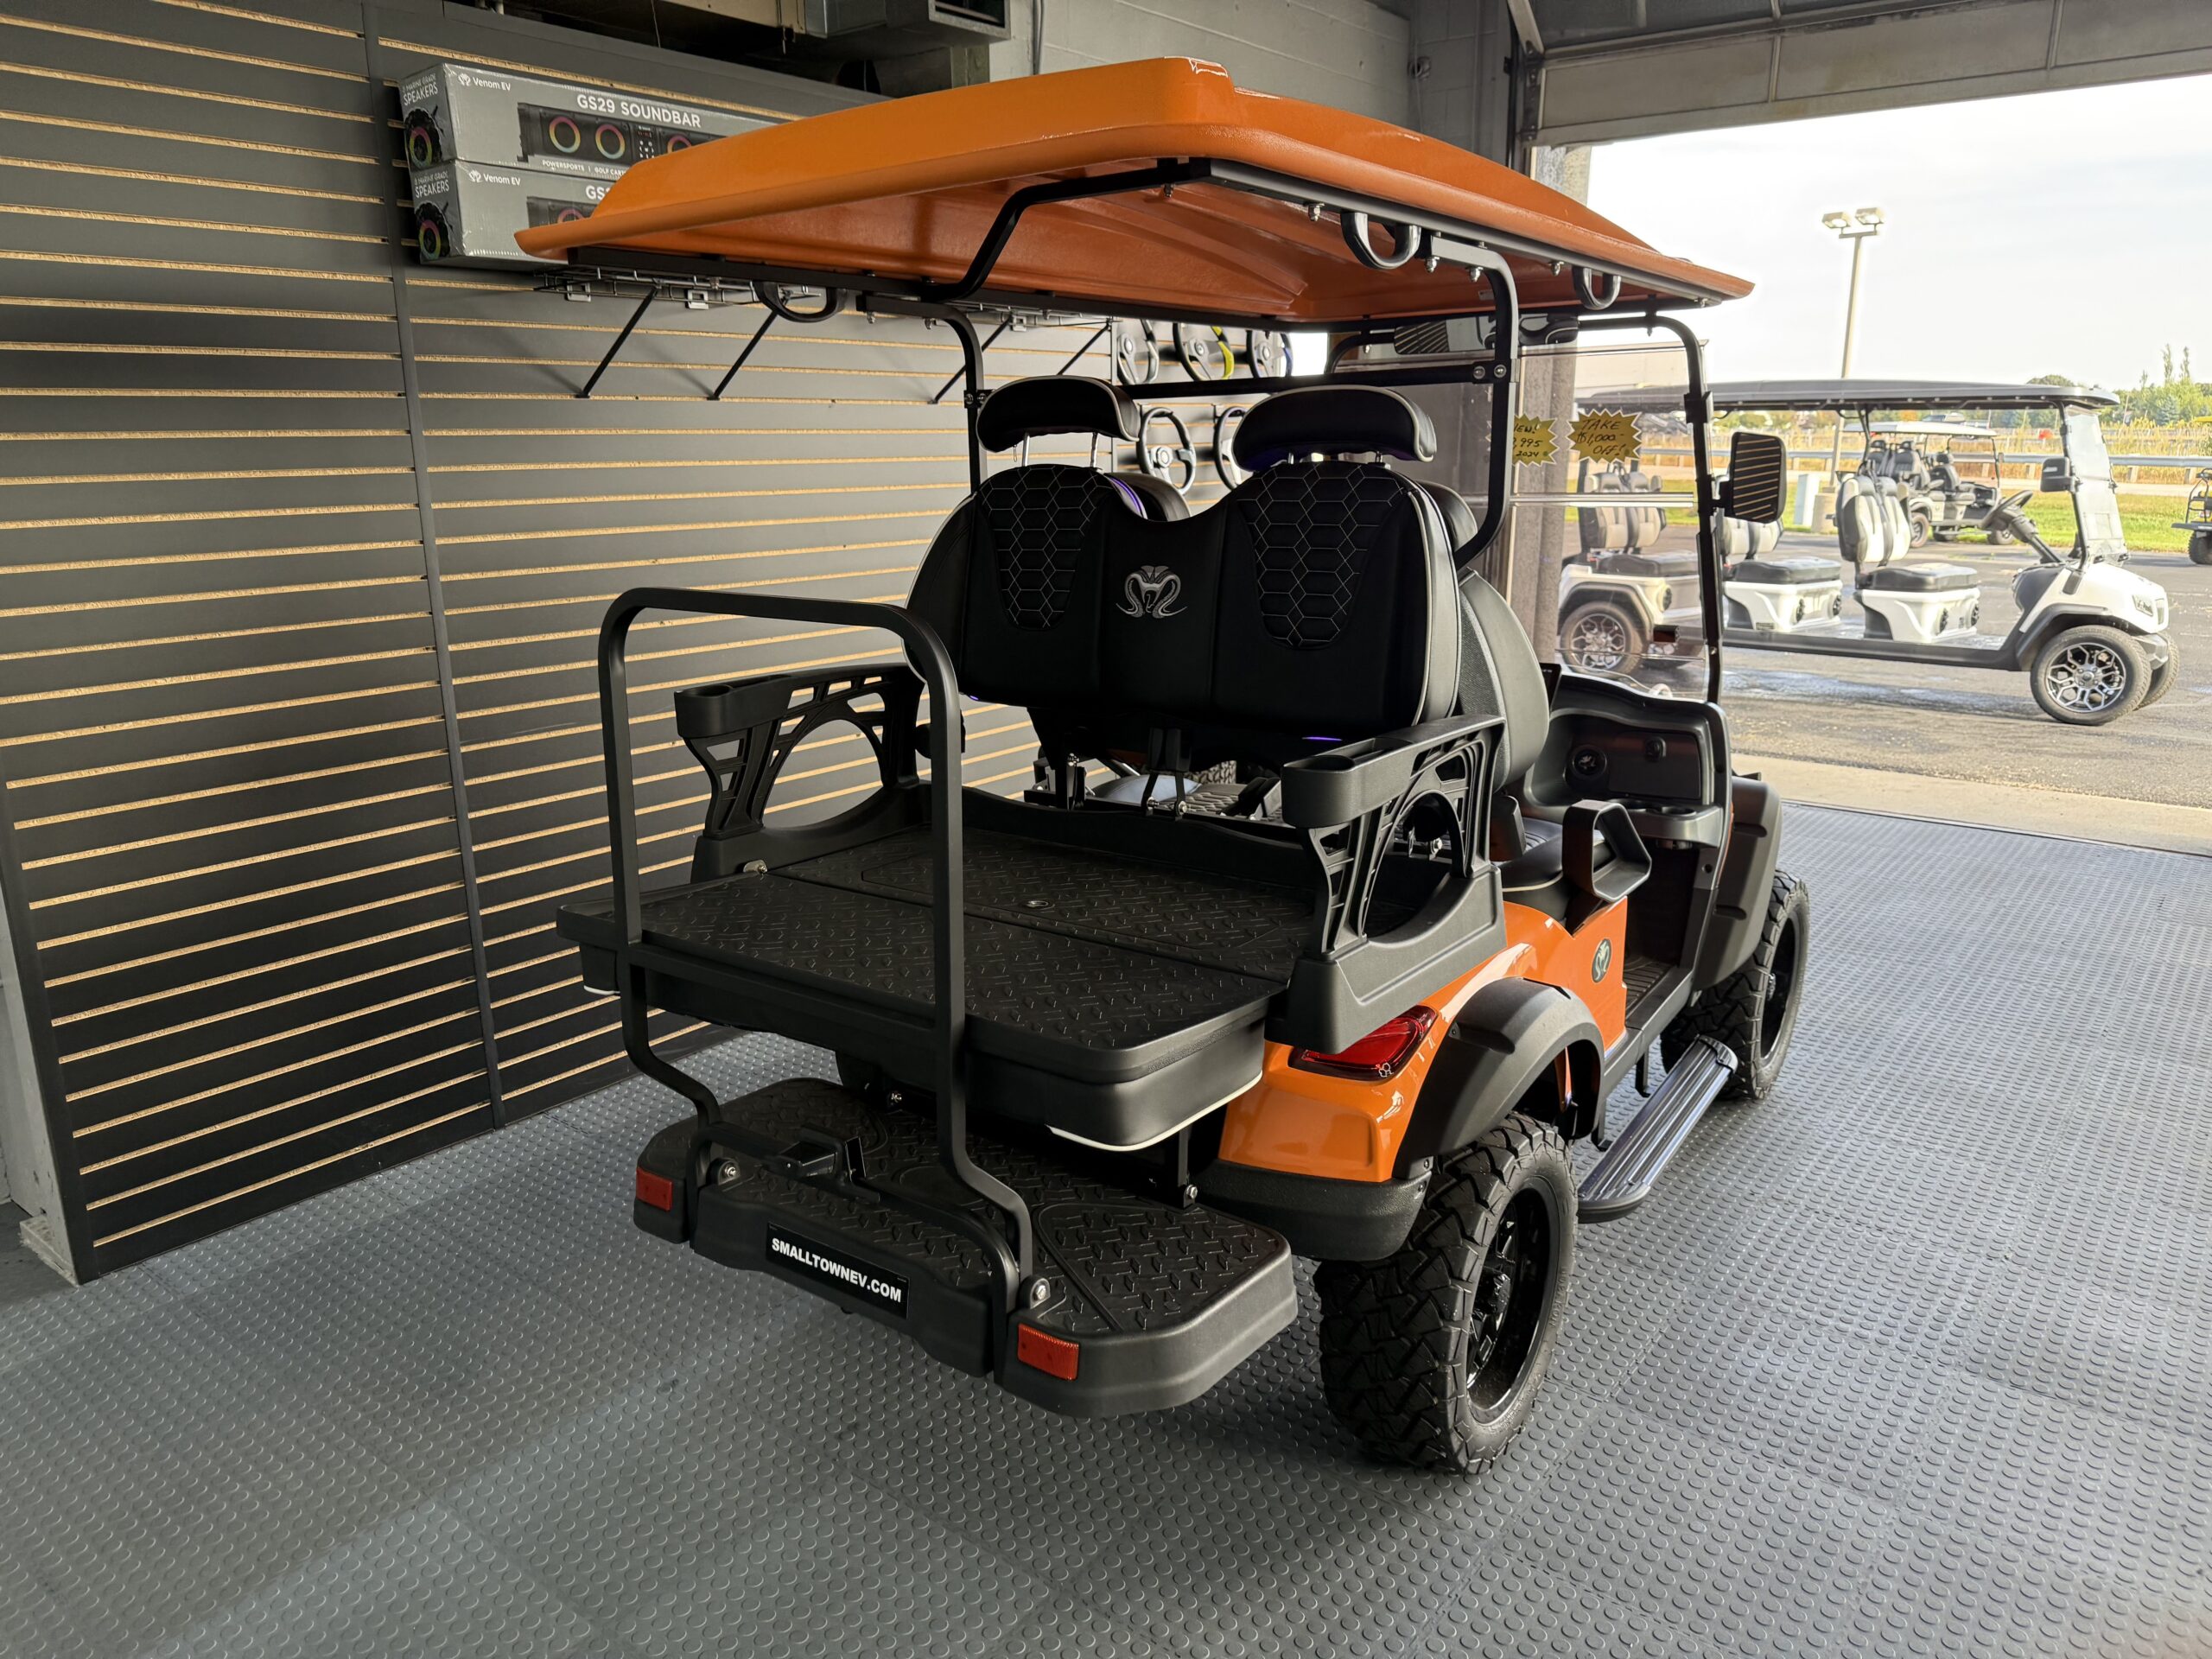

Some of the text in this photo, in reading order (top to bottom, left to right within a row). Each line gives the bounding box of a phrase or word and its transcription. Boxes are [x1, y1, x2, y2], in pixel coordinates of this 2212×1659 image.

[473, 77, 512, 92] Venom EV
[404, 82, 438, 105] SPEAKERS
[576, 94, 702, 129] GS29 SOUNDBAR
[542, 160, 585, 172] POWERSPORTS
[484, 174, 521, 186] Venom EV
[415, 179, 449, 199] SPEAKERS
[585, 185, 610, 200] GS
[1581, 418, 1621, 430] TAKE
[1592, 443, 1626, 456] OFF!
[772, 1237, 902, 1303] SMALLTOWNEV.COM
